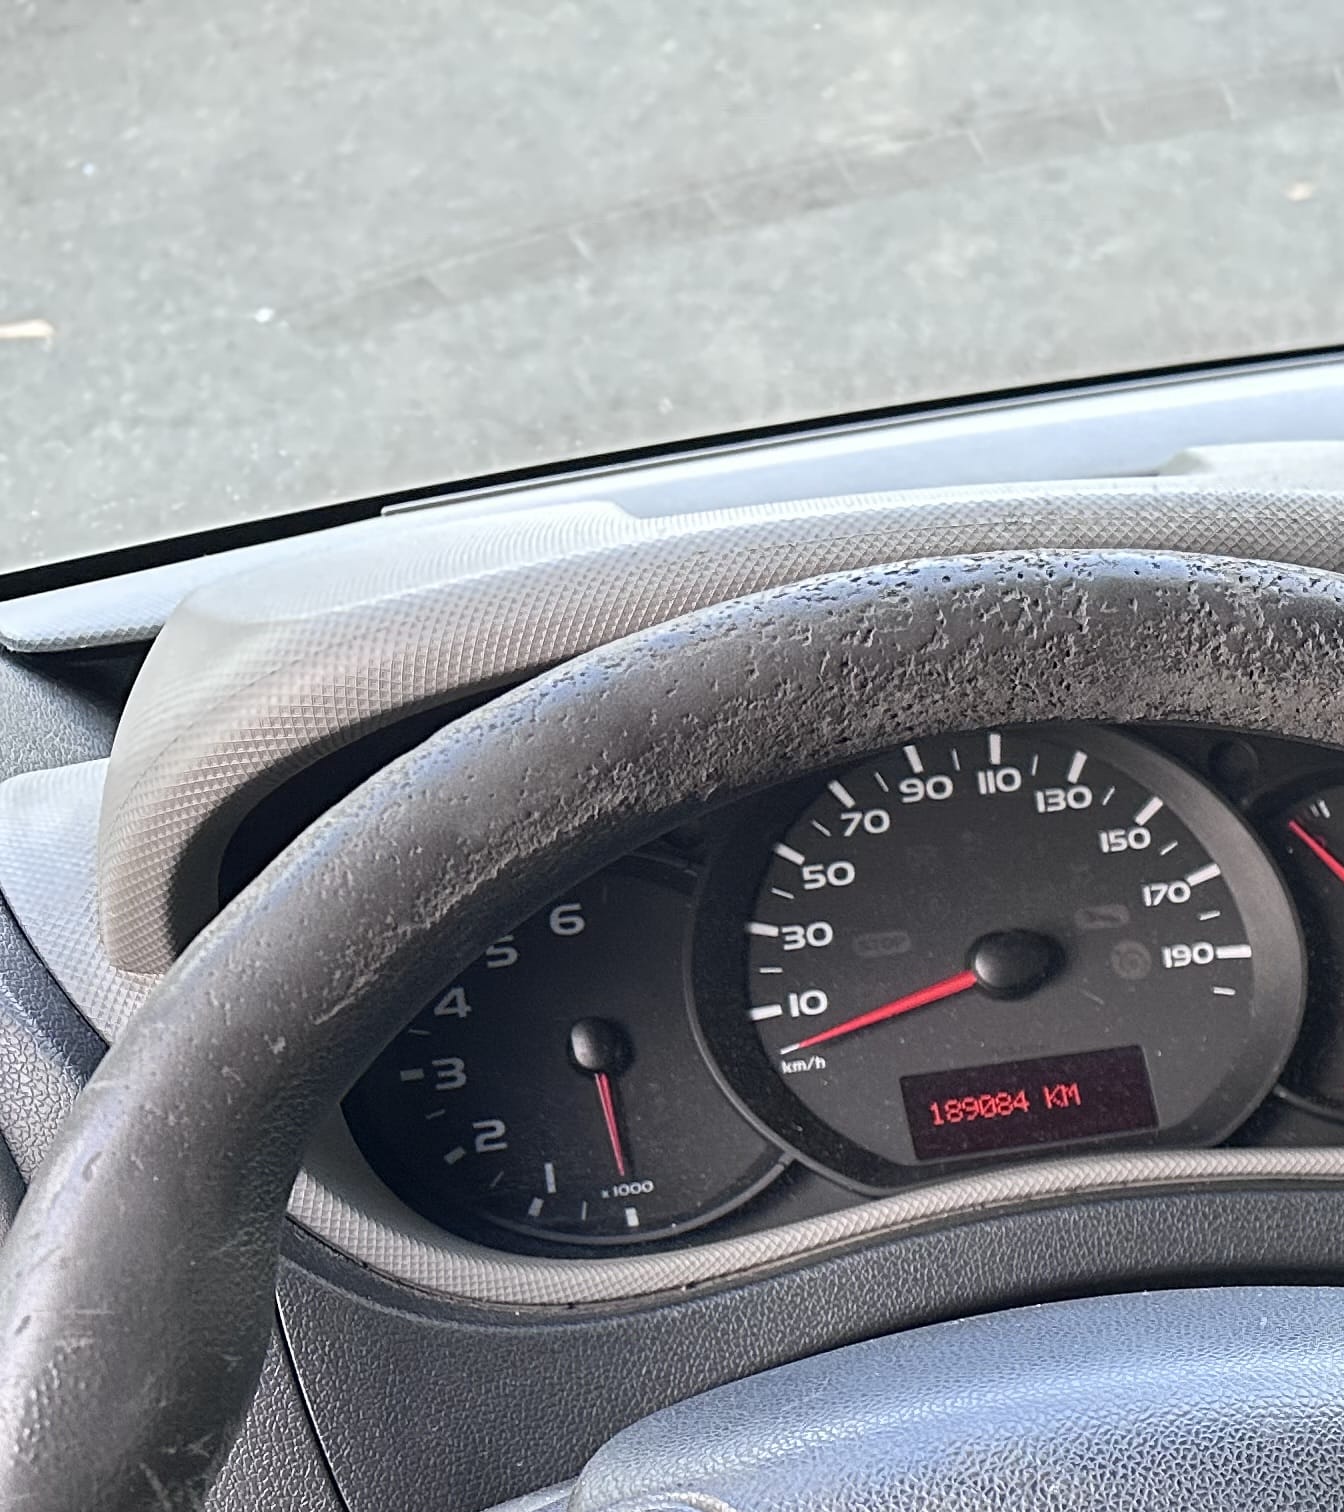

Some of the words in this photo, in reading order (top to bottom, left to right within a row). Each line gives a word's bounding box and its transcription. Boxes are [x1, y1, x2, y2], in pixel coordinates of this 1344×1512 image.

[899, 775, 953, 803] 90
[977, 767, 1022, 795] 110
[1034, 785, 1093, 813] 130
[840, 808, 890, 837] 70
[1099, 827, 1152, 853] 150
[801, 862, 856, 889] 50
[1142, 881, 1191, 906] 170
[550, 903, 586, 936] 6
[781, 922, 833, 950] 30
[486, 935, 519, 968] 5
[1161, 941, 1214, 968] 190
[433, 987, 472, 1018] 4
[788, 989, 829, 1018] 10
[432, 1057, 467, 1090] 3
[780, 1056, 826, 1074] km/h
[929, 1090, 1030, 1126] 189084
[1043, 1083, 1082, 1109] KM
[472, 1119, 508, 1153] 2
[544, 1163, 557, 1193] 1
[613, 1180, 654, 1197] 1000
